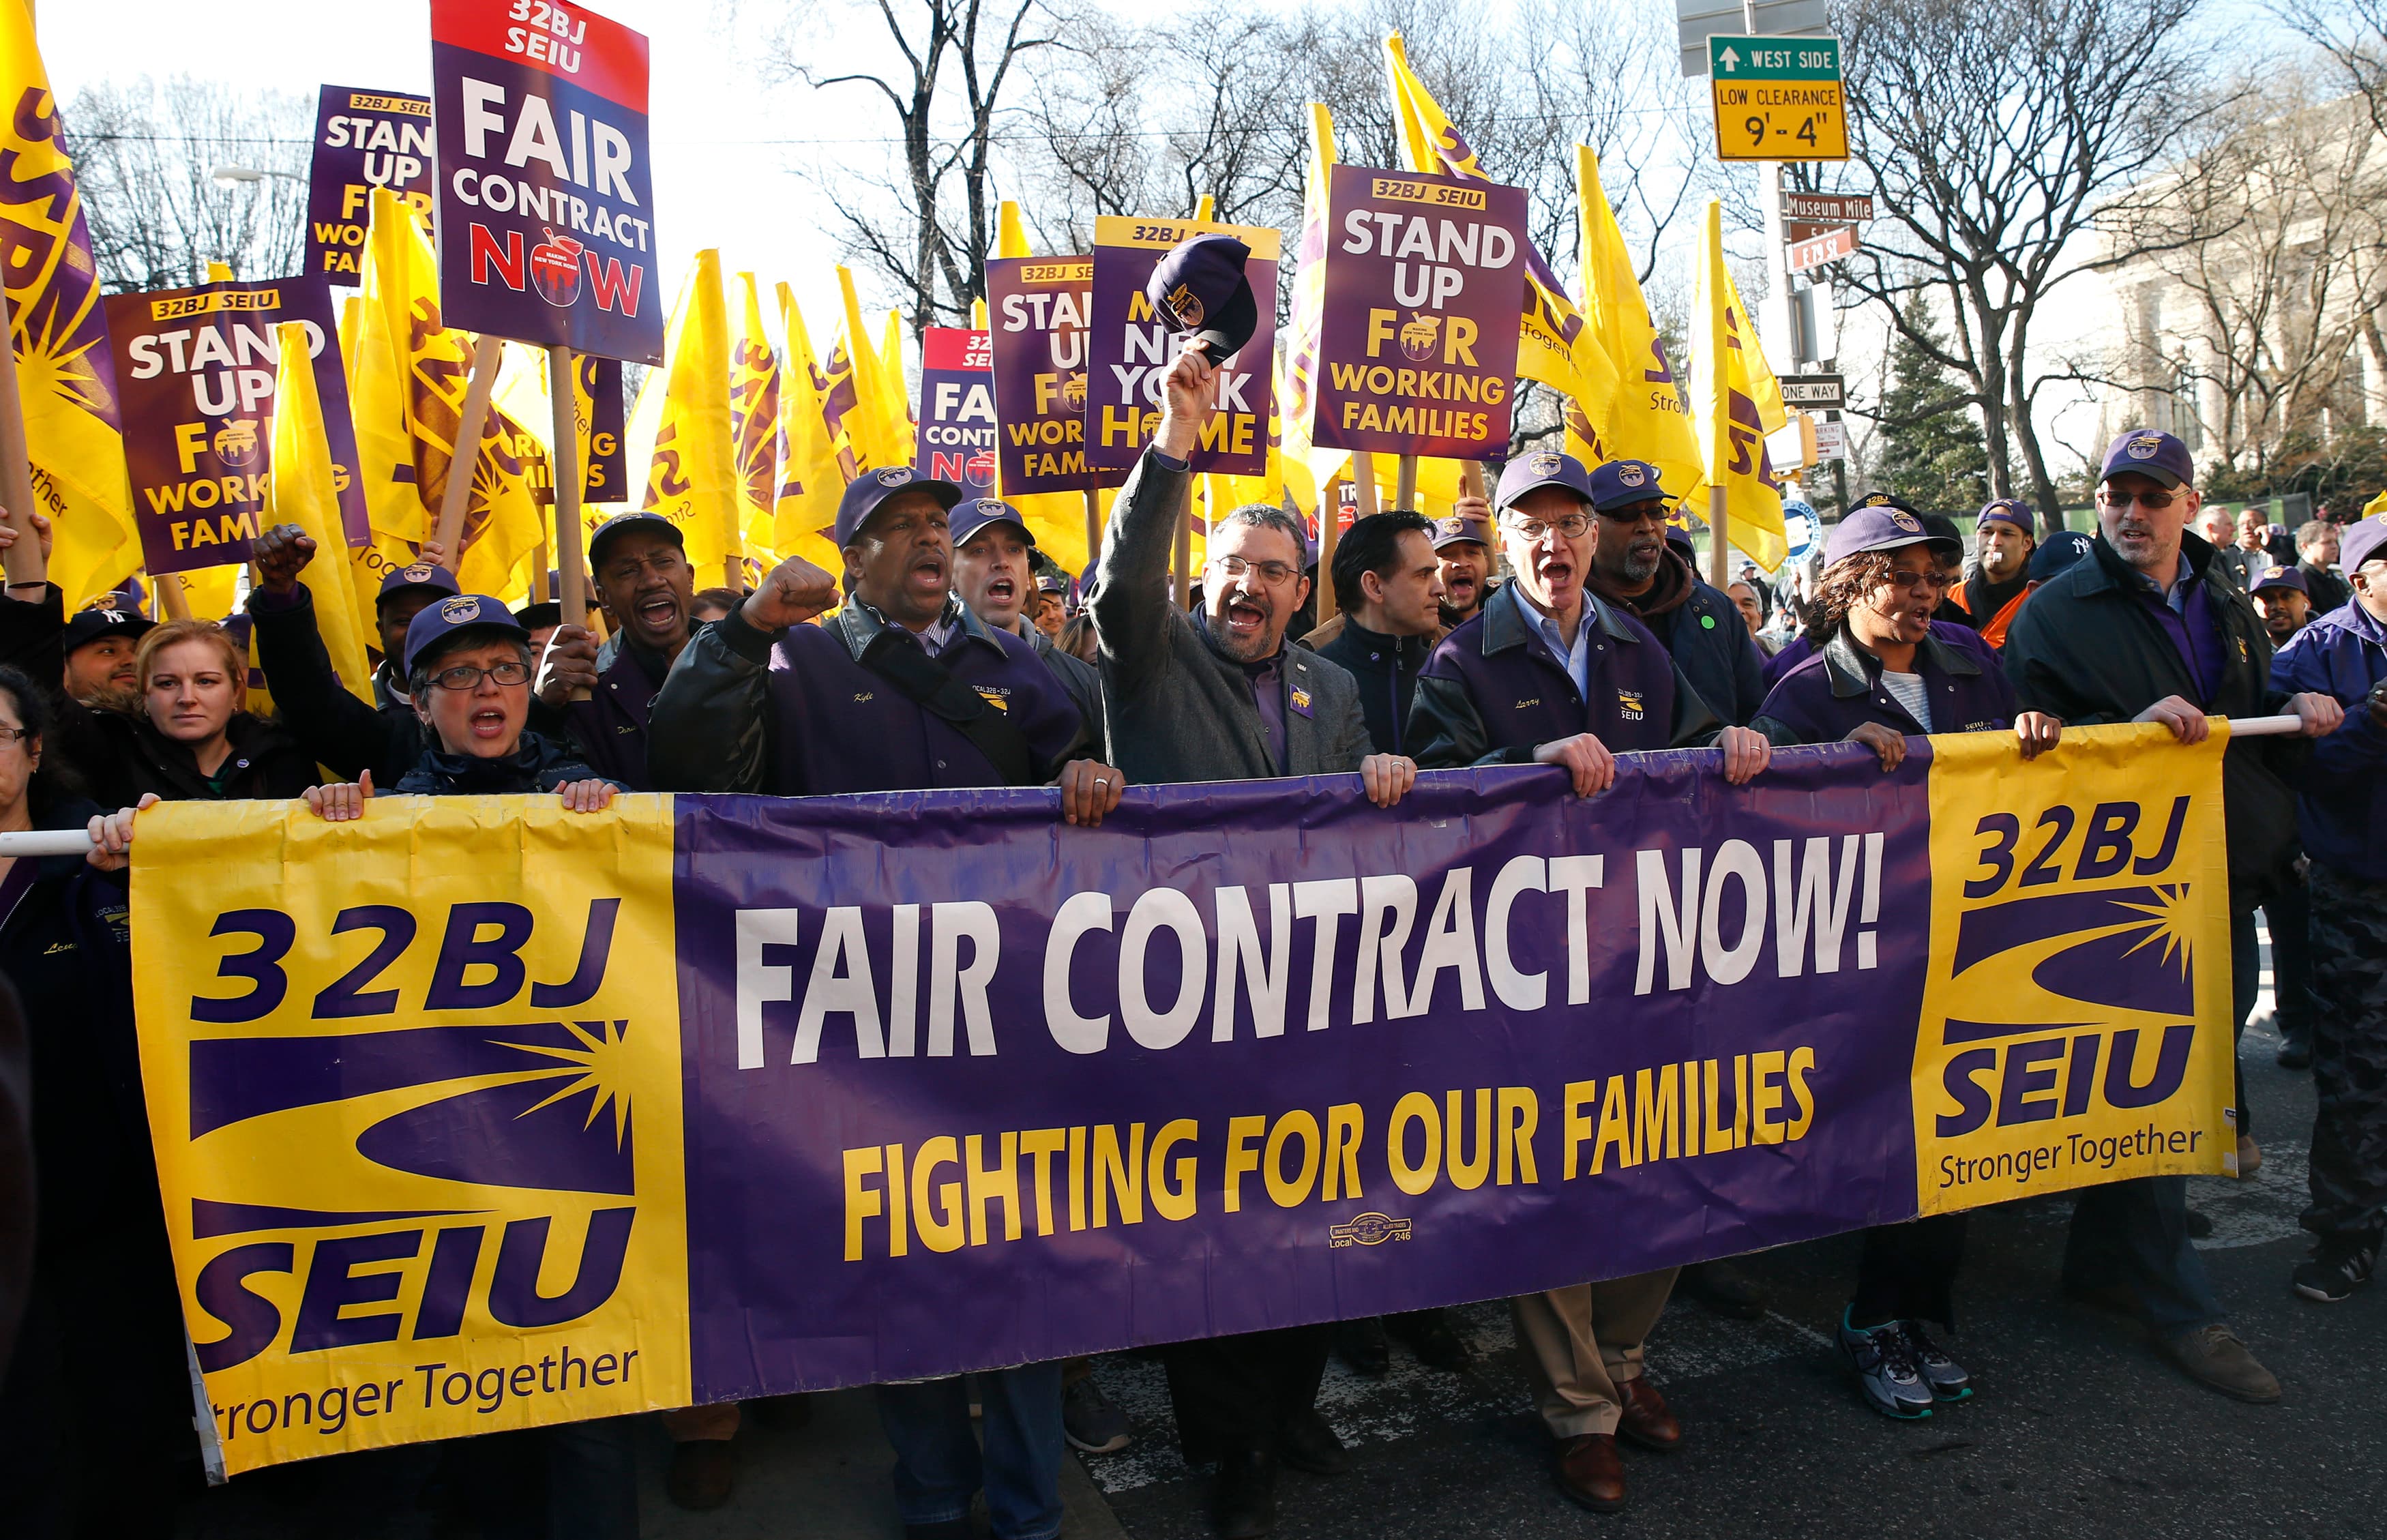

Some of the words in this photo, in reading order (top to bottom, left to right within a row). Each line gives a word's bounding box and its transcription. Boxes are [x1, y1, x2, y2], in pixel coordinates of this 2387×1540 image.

[509, 0, 587, 45] 32BJ
[505, 27, 581, 74] SEIU
[1751, 50, 1791, 68] WEST
[1798, 51, 1833, 69] SIDE
[353, 96, 393, 109] 32BJ
[1720, 89, 1747, 105] LOW
[1757, 89, 1837, 106] CLEARANCE
[462, 76, 640, 207] FAIR
[363, 151, 421, 186] UP
[452, 168, 649, 252] CONTRACT
[1375, 181, 1427, 200] 32BJ
[1436, 188, 1483, 207] SEIU
[1789, 198, 1840, 217] Museum
[1845, 200, 1871, 218] Mile
[1132, 226, 1185, 243] 32BJ
[1341, 209, 1516, 269] STAND
[1803, 248, 1810, 266] E
[1811, 243, 1824, 262] 79
[1826, 238, 1838, 259] St
[1024, 267, 1066, 280] 32BJ
[1393, 262, 1464, 310] UP
[158, 295, 209, 317] 32BJ
[222, 293, 275, 311] SEIU
[192, 370, 275, 416] UP
[1330, 362, 1506, 406] WORKING
[1782, 385, 1805, 399] ONE
[1811, 385, 1835, 399] WAY
[1342, 402, 1489, 441] FAMILIES
[1866, 495, 1888, 506] 32BJ
[853, 692, 874, 703] Kyle
[1515, 698, 1540, 709] Larry
[1621, 710, 1644, 721] SEIU
[1965, 721, 1983, 730] SEIU
[1962, 795, 2191, 898] 32BJ
[189, 898, 622, 1024] 32BJ
[735, 900, 1000, 1071] FAIR
[1042, 853, 1604, 1055] CONTRACT
[1634, 831, 1885, 996] NOW!
[1935, 1024, 2195, 1138] SEIU
[841, 1118, 1199, 1262] FIGHTING
[1224, 1102, 1365, 1214] FOR
[1387, 1085, 1540, 1197] OUR
[1562, 1046, 1817, 1182] FAMILIES
[1940, 1142, 2062, 1188] Stronger
[2067, 1123, 2203, 1166] Together
[1329, 1238, 1352, 1248] Local
[1394, 1232, 1411, 1241] 246
[195, 1205, 638, 1374] SEIU
[415, 1346, 639, 1410] Together
